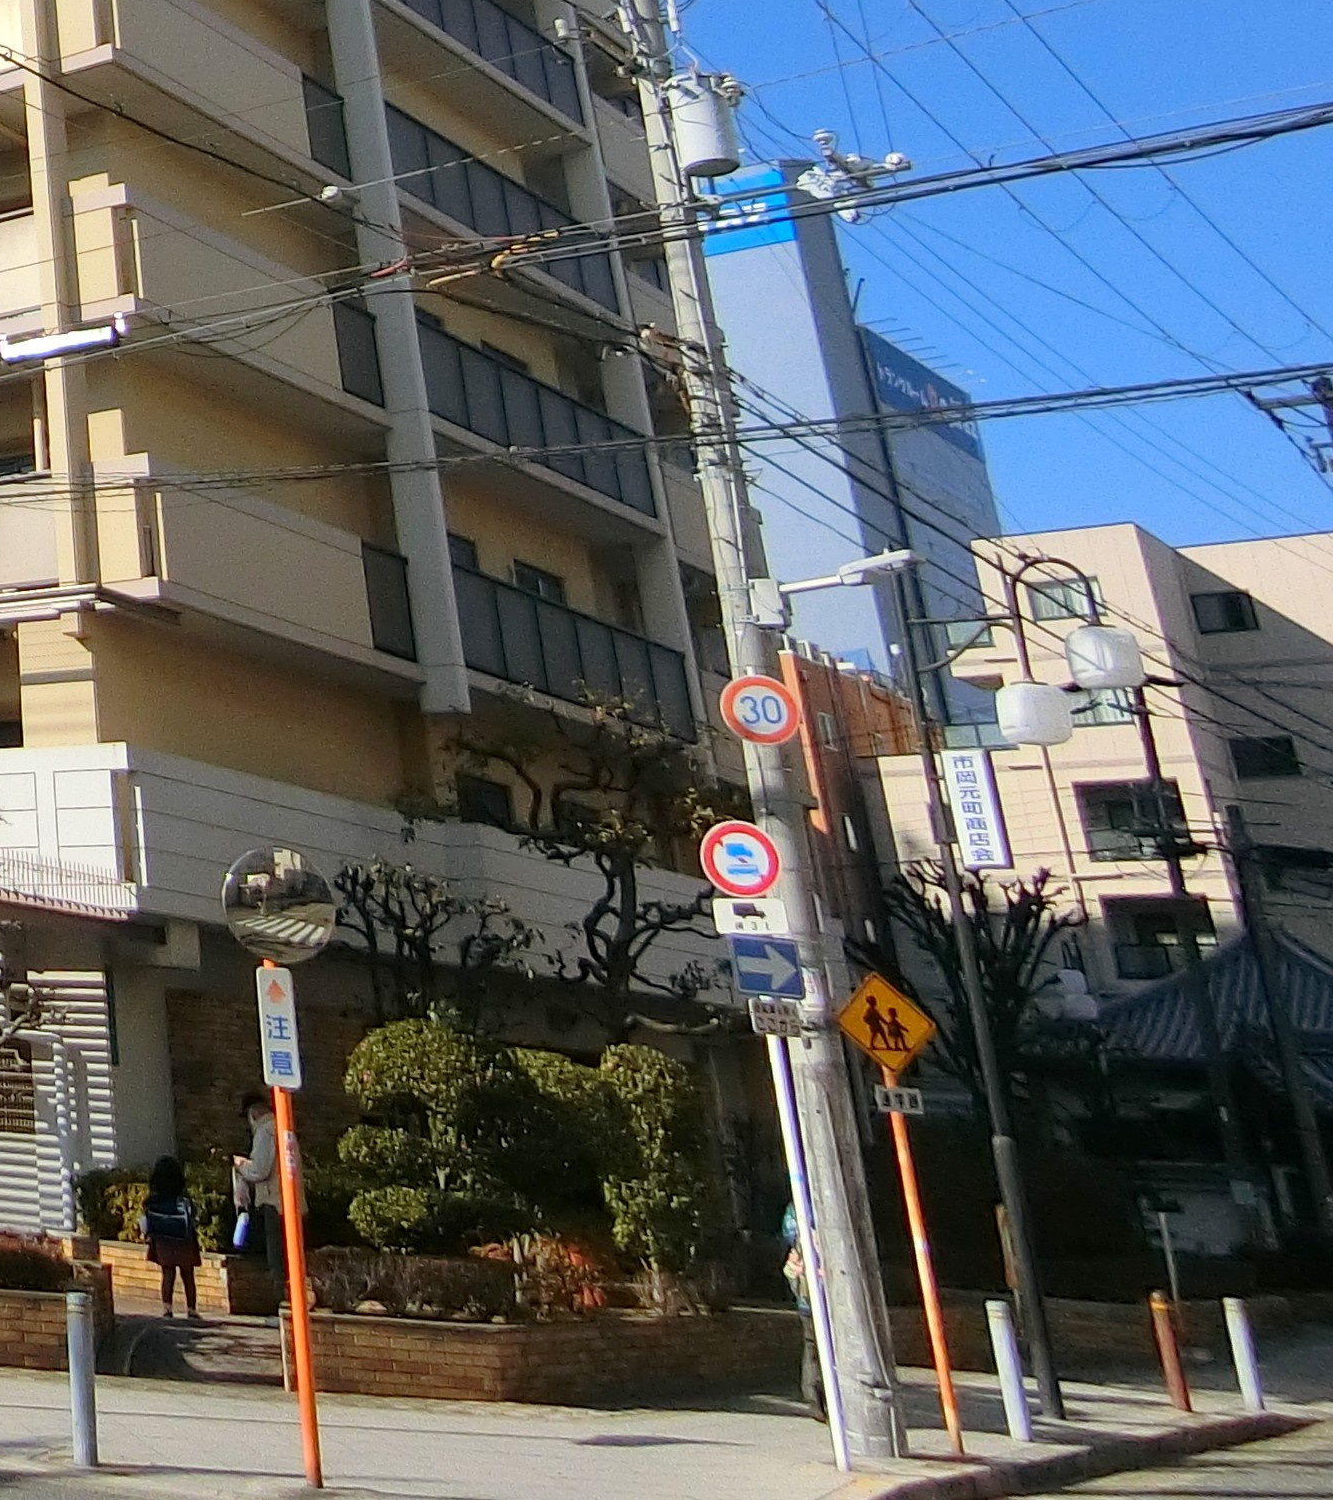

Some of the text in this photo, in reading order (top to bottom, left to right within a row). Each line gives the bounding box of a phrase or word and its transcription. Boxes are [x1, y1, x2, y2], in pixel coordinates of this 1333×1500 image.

[740, 695, 782, 725] 30
[951, 755, 994, 862] 市岡元町商店会
[266, 1014, 294, 1076] 注意
